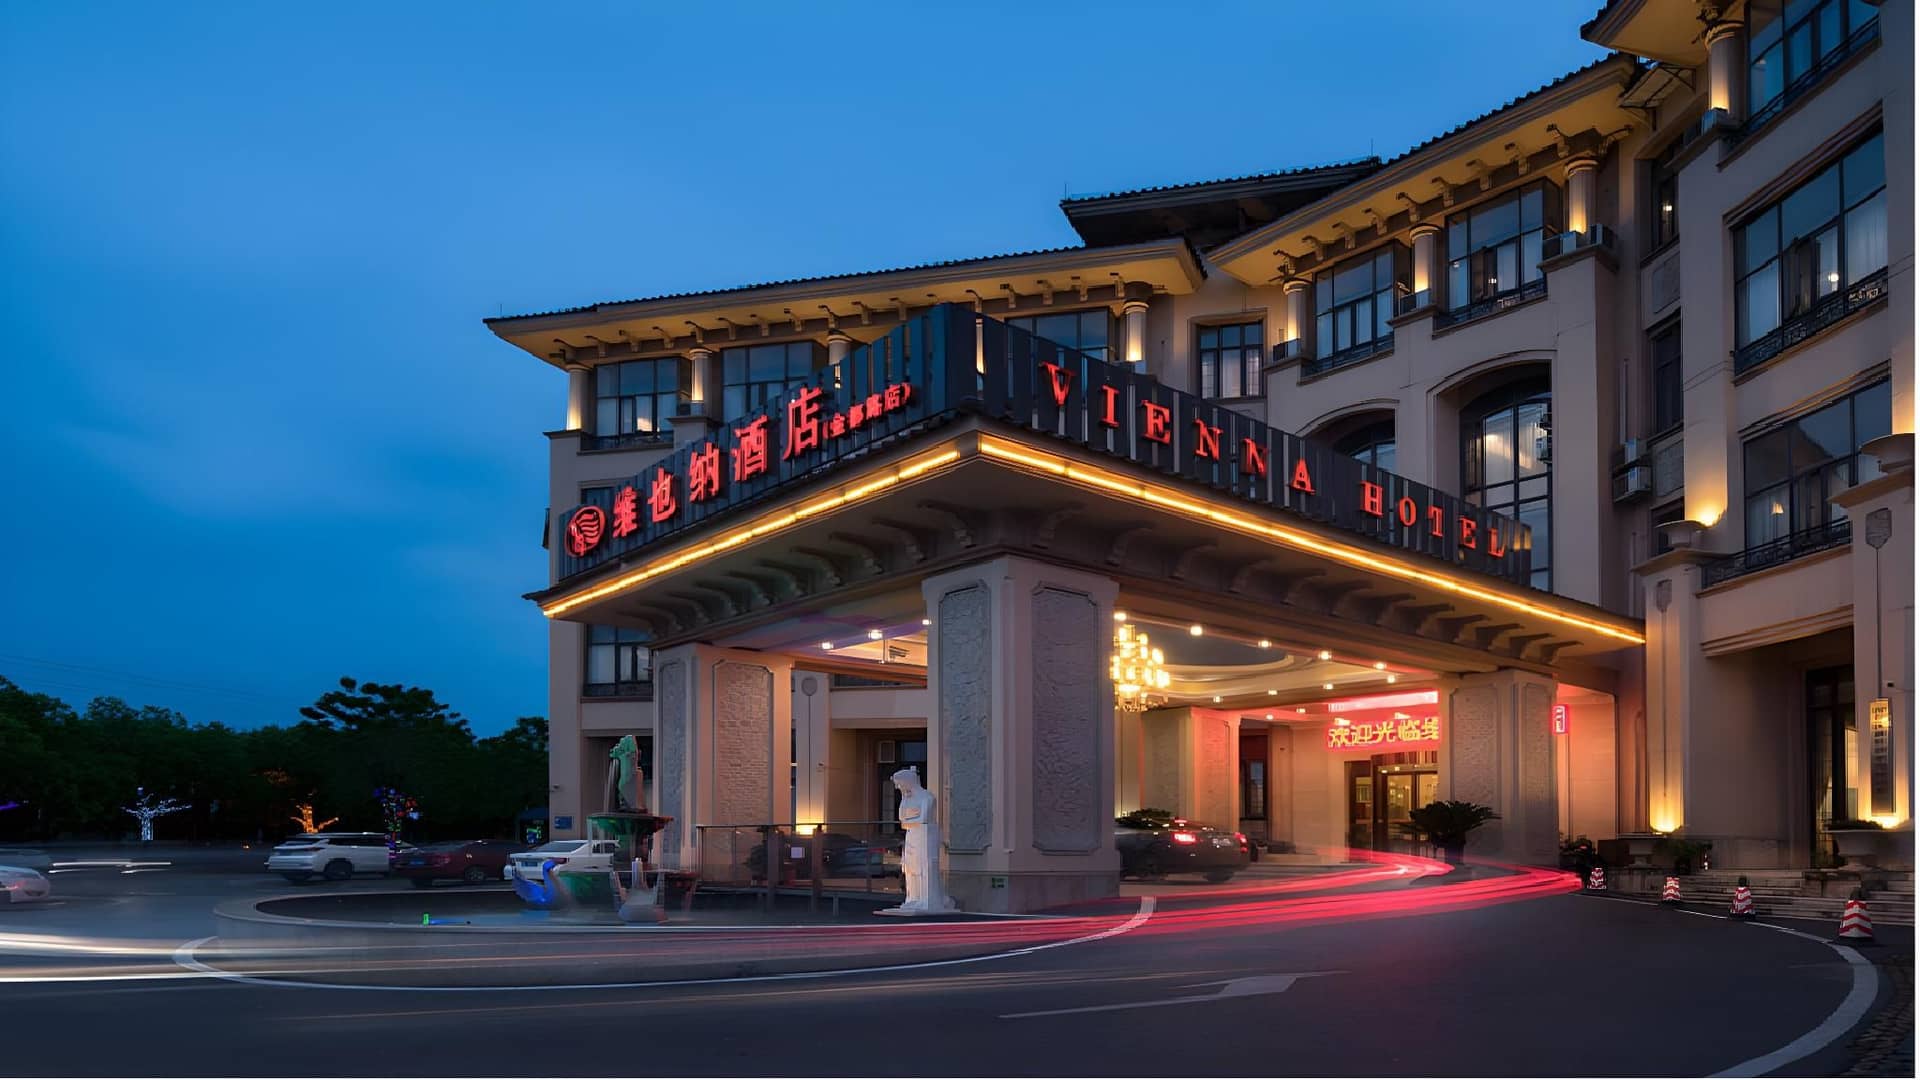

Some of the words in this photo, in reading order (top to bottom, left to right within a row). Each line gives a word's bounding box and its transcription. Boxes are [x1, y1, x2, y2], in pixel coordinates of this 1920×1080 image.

[612, 386, 824, 539] 维也纳酒店
[1040, 361, 1315, 496] VIENNA
[1359, 480, 1507, 558] HOTEL
